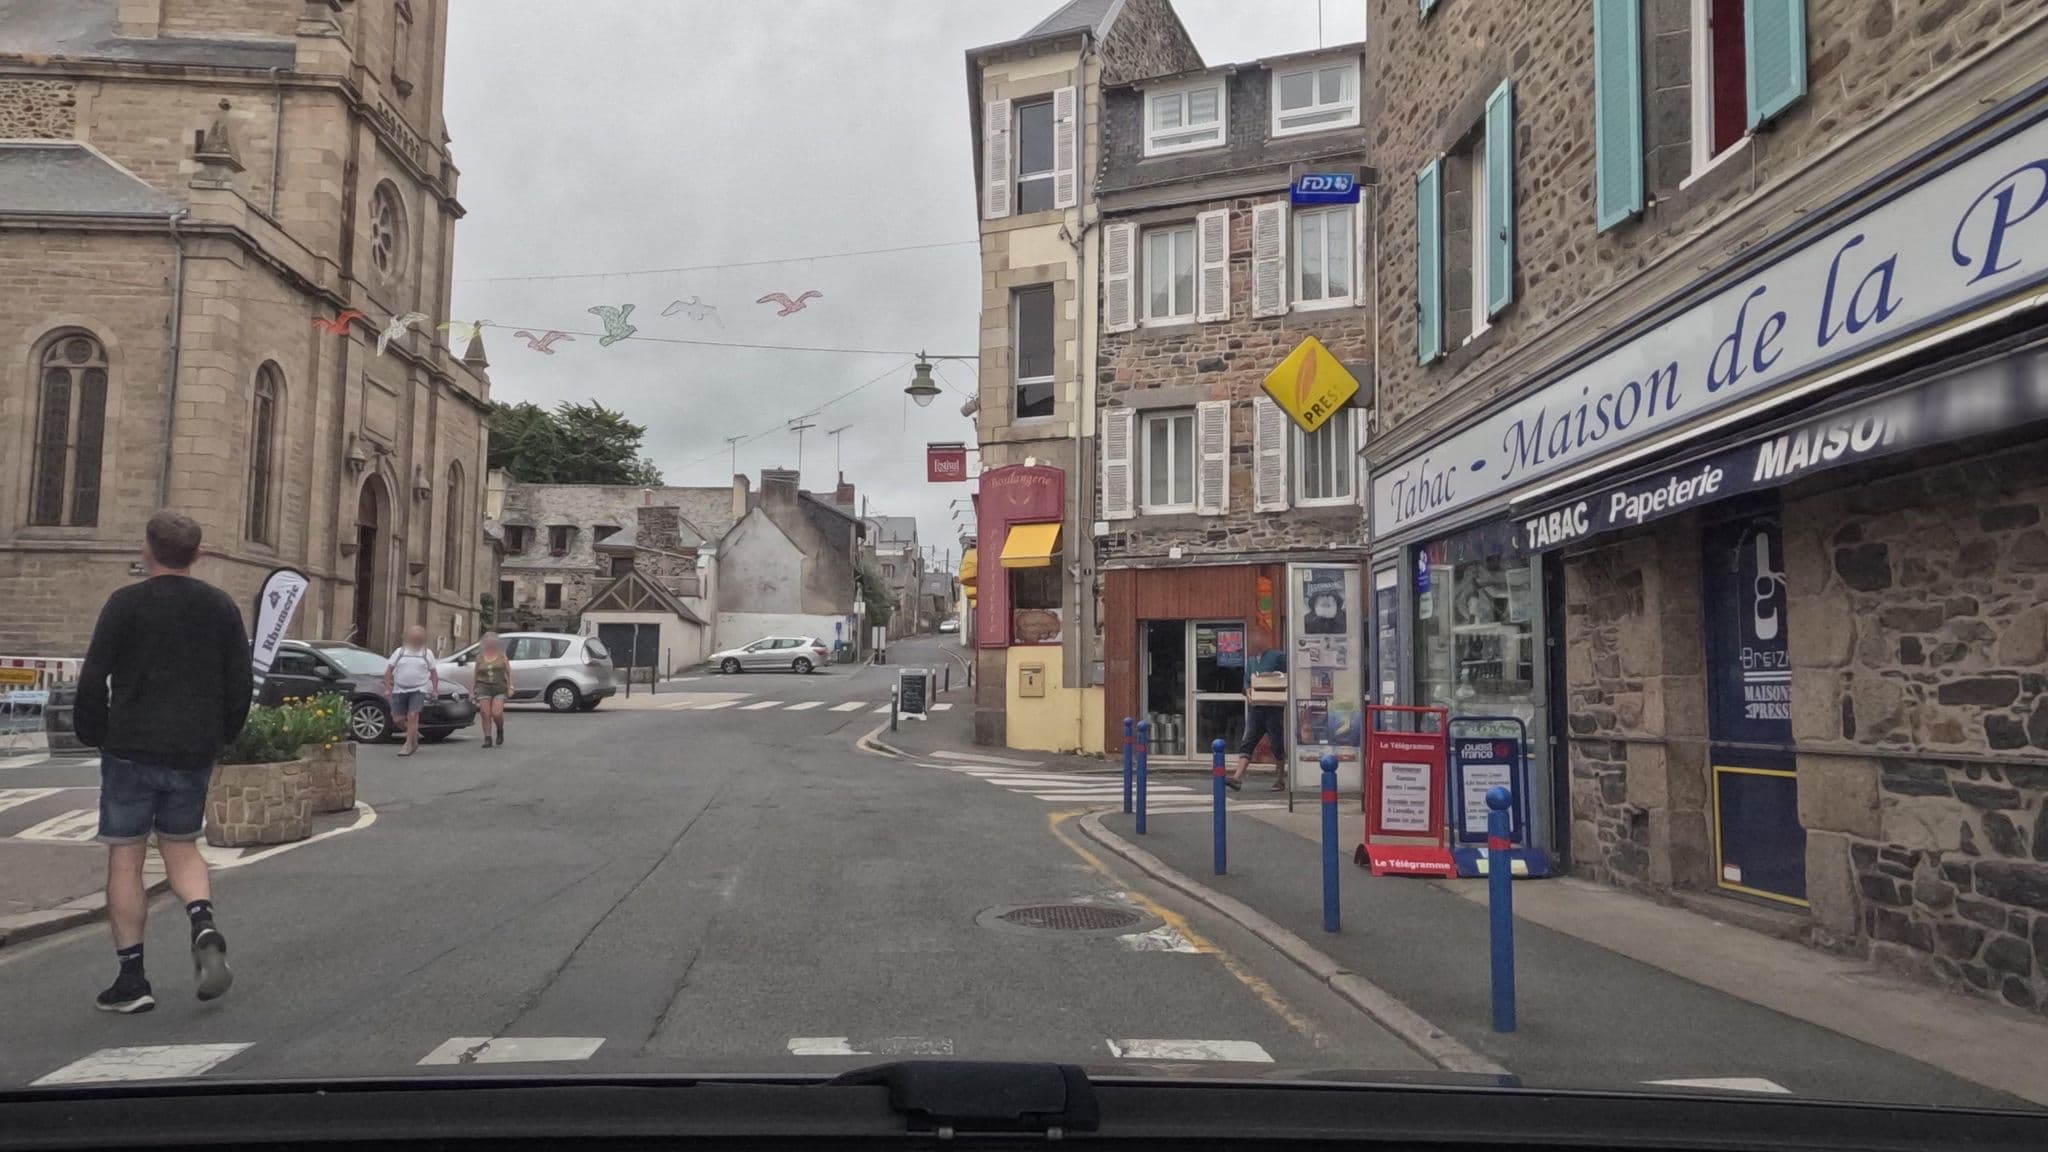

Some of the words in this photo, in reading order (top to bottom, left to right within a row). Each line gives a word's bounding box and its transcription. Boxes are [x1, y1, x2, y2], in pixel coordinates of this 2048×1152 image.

[1302, 177, 1332, 190] FDJ
[1391, 458, 1456, 524] Tabac
[1501, 360, 1682, 480] Maison
[1707, 285, 1786, 393] de
[1817, 234, 1903, 347] la
[991, 472, 1052, 488] Boulangerie
[1526, 502, 1589, 549] TABAC
[1609, 465, 1723, 524] Papeterie
[262, 584, 299, 652] Rhumerie
[1390, 742, 1435, 751] Télégramme
[1464, 742, 1493, 751] ouest
[1461, 749, 1493, 759] france
[1375, 859, 1387, 868] Le
[1389, 859, 1451, 870] Télégramme
